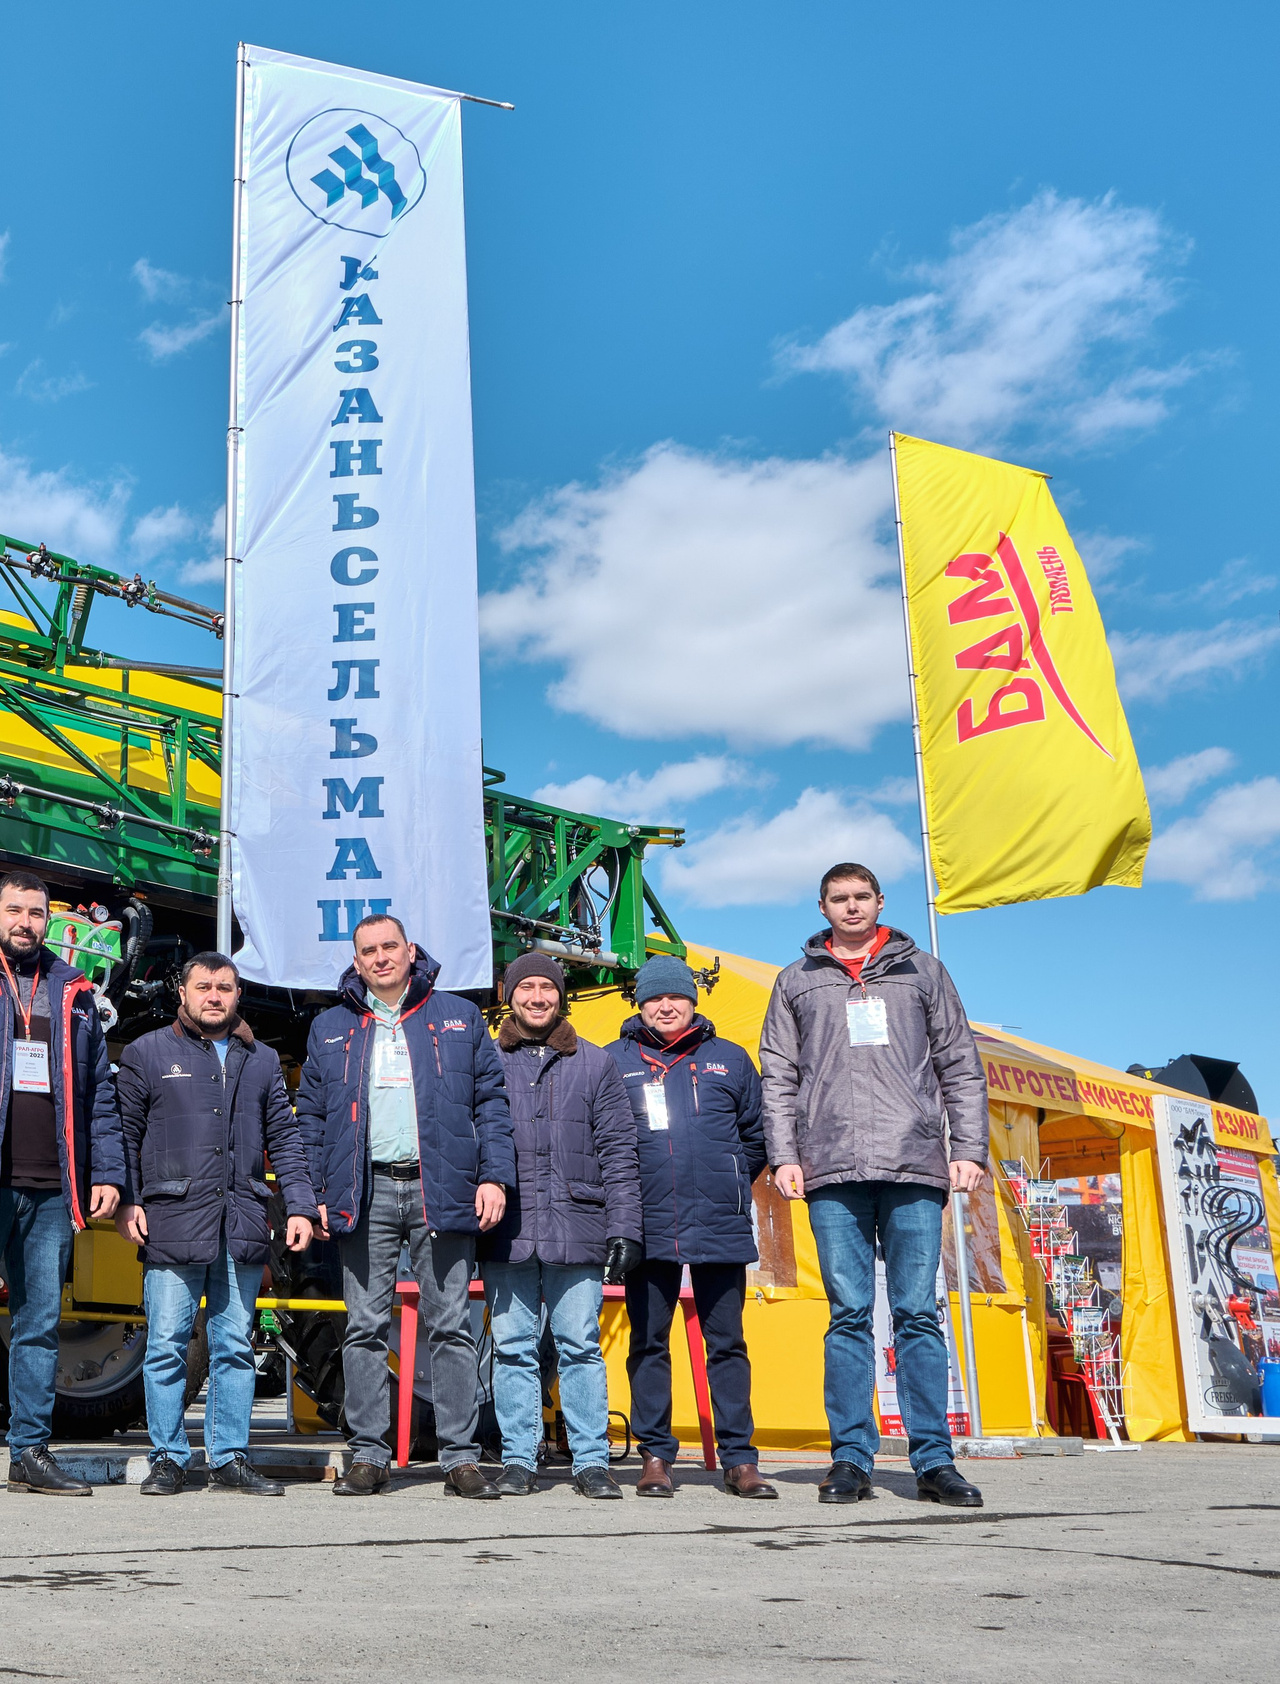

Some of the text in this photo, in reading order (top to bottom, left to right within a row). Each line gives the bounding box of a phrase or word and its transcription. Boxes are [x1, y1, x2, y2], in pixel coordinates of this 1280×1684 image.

[317, 254, 392, 942] КАЗАНЬСЕЛЬМАШ
[1036, 545, 1075, 615] ТЮМЕНЬ
[944, 552, 1047, 745] БАМ
[443, 1020, 463, 1028] БАМ
[1170, 1104, 1182, 1113] ООО
[1211, 1108, 1259, 1140] АЗИН
